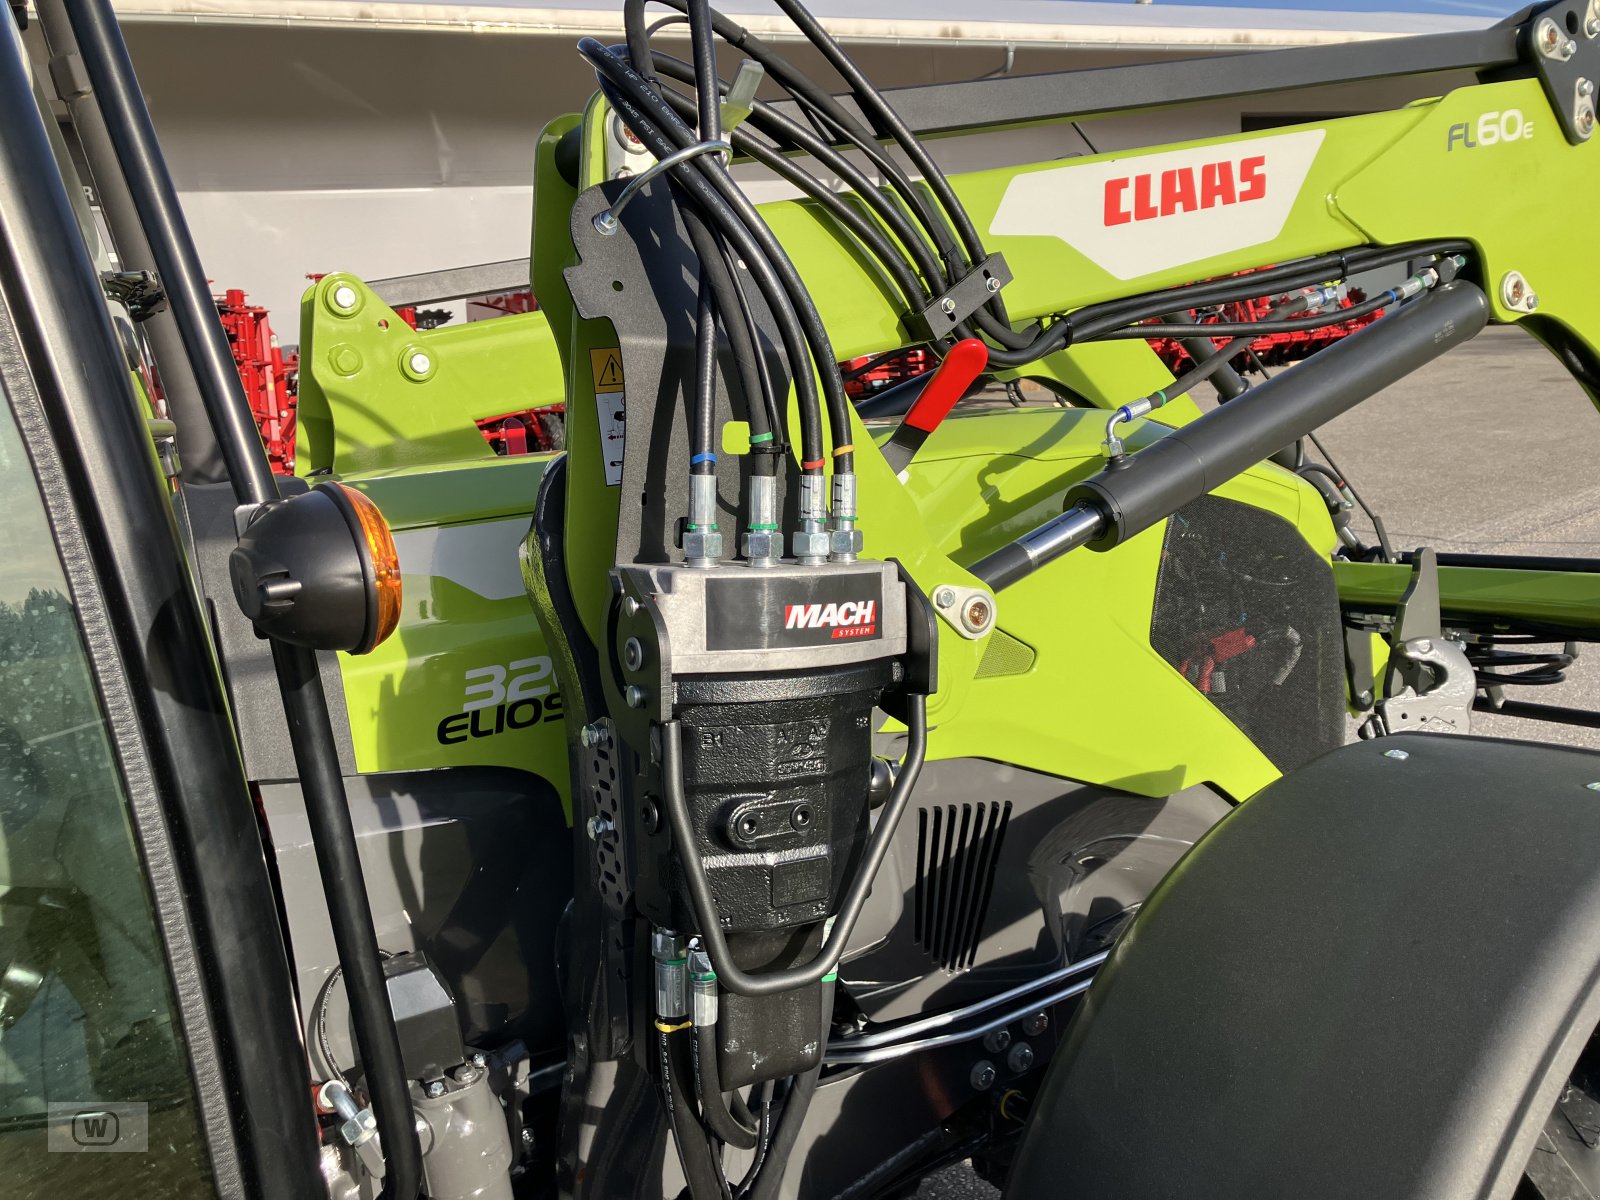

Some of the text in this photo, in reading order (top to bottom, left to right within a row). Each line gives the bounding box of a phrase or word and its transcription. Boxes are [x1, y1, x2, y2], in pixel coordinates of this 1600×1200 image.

[640, 84, 658, 103] 210
[639, 119, 655, 135] PSI
[1103, 155, 1266, 227] CLAAS
[785, 600, 874, 629] MACH
[838, 627, 870, 637] SYSTEM
[463, 655, 560, 712] 32
[437, 692, 564, 746] ELIOS
